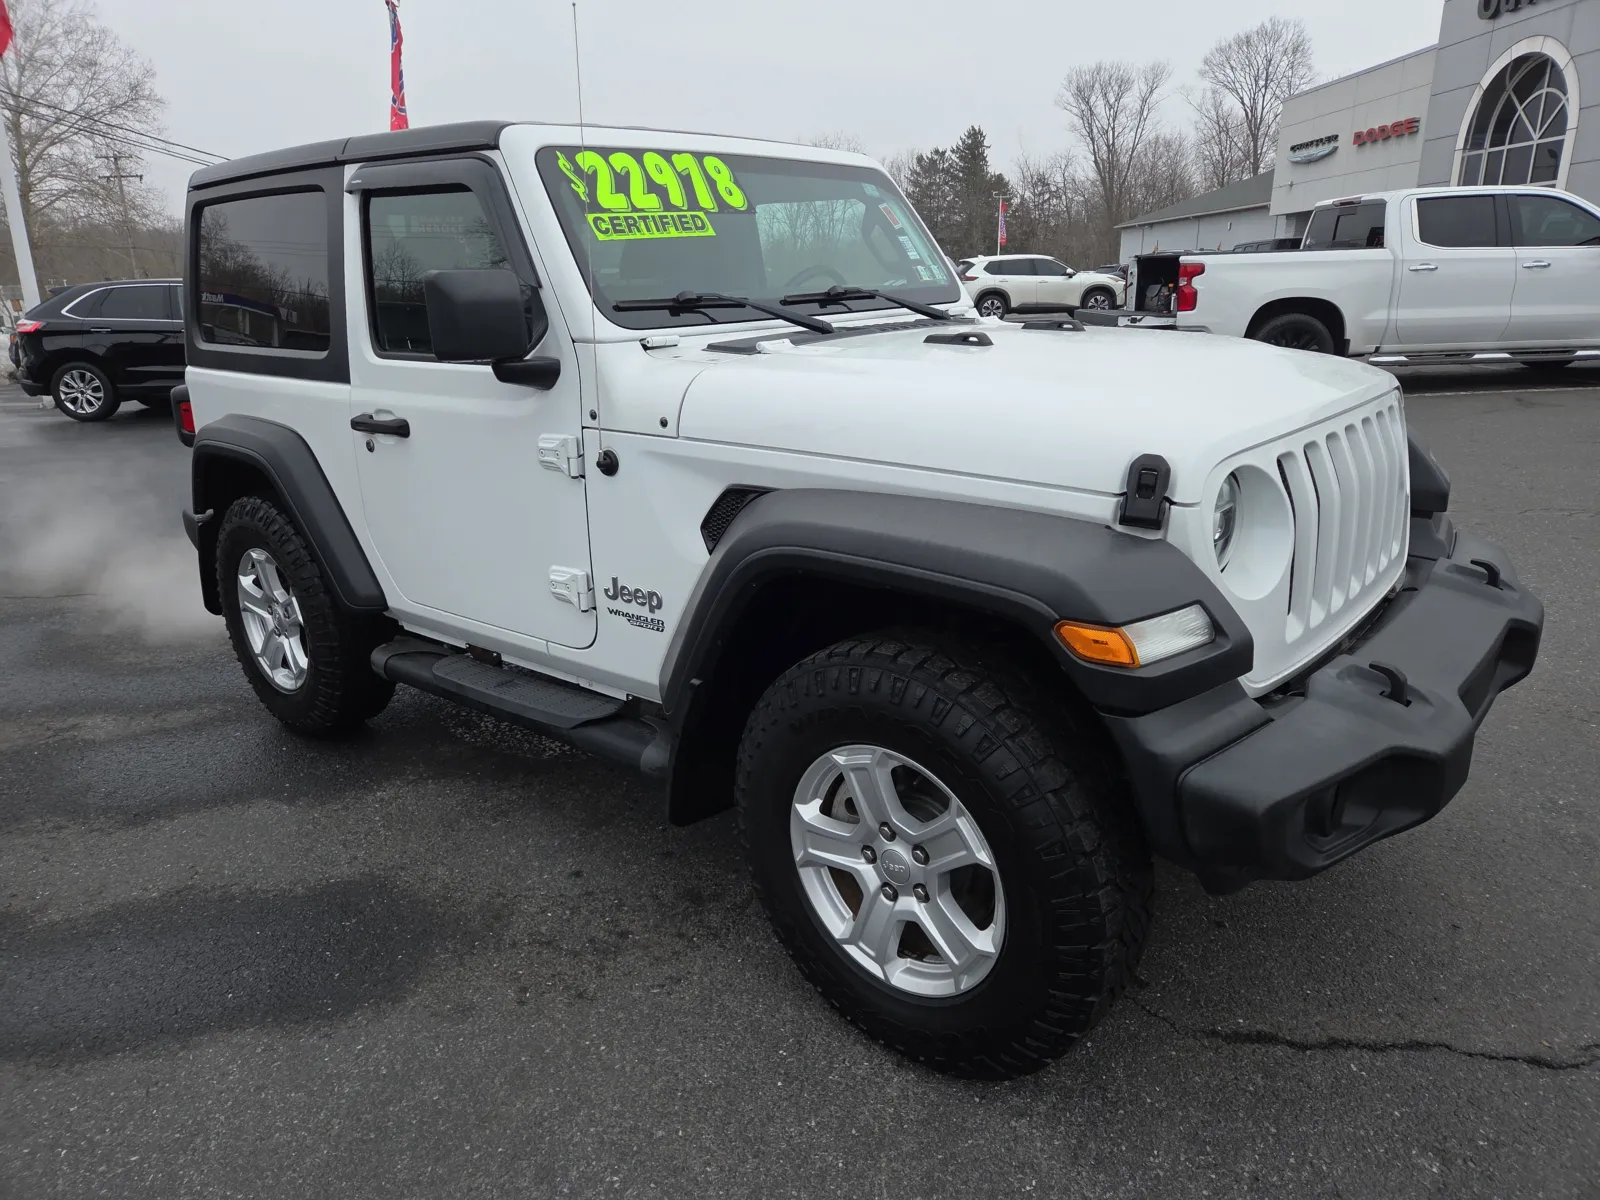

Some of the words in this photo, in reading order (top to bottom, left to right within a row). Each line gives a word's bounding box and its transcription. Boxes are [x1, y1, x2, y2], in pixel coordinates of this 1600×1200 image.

[1353, 117, 1420, 146] DODGE
[556, 150, 748, 212] $22978
[591, 213, 709, 236] CERTIFIED
[603, 574, 663, 614] Jeep
[607, 606, 665, 627] WRANGLER
[629, 618, 665, 633] SPORT
[882, 860, 906, 873] Jeep
